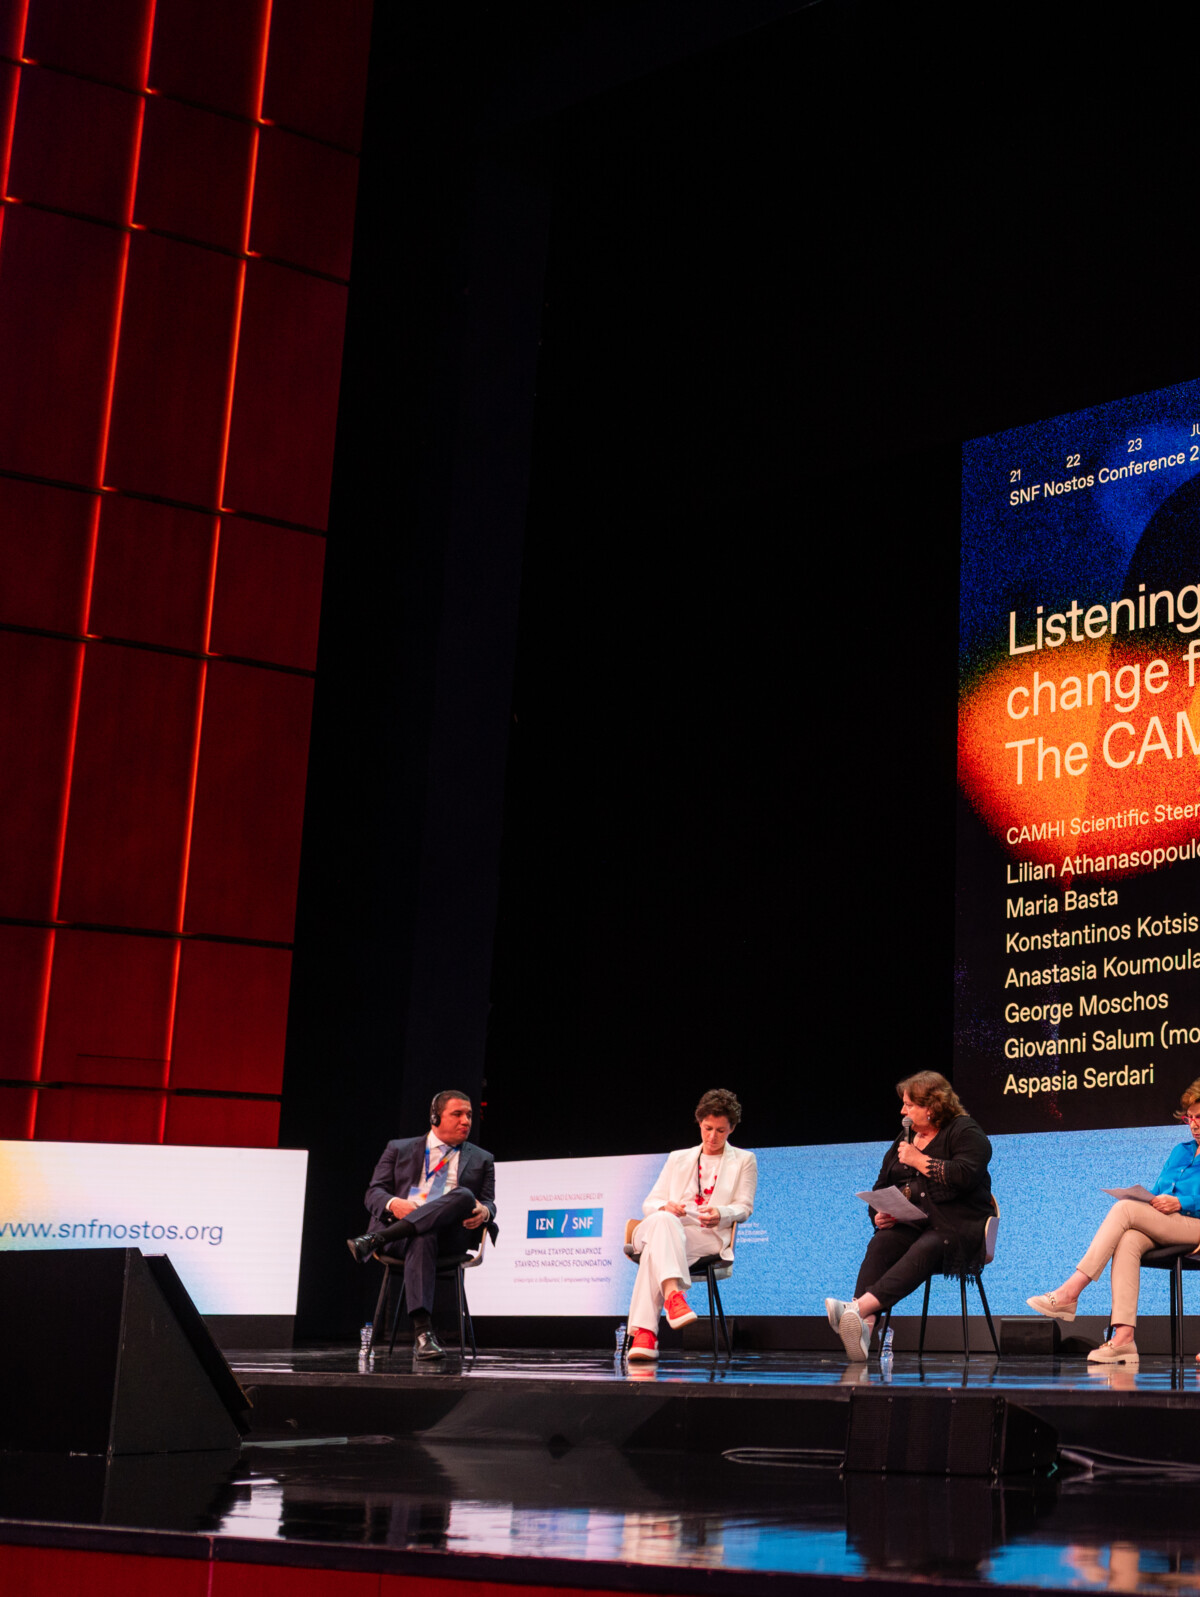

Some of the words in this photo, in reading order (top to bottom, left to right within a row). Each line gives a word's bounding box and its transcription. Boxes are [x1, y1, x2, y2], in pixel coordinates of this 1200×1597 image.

[1010, 469, 1021, 483] 21
[1066, 453, 1081, 468] 22
[1127, 437, 1143, 453] 23
[1009, 484, 1041, 506] SNF
[1044, 475, 1095, 498] Nostos
[1098, 452, 1186, 484] Conference
[1006, 659, 1170, 720] change
[1004, 730, 1089, 785] The
[1006, 819, 1065, 845] CAMHI
[1070, 808, 1150, 835] Scientific
[1007, 861, 1055, 884] Lilian
[1006, 894, 1058, 919] Maria
[1064, 887, 1118, 912] Basta
[1006, 923, 1131, 954] Konstantinos
[1137, 912, 1199, 938] Kotsis
[1004, 960, 1097, 989] Anastasia
[1005, 1002, 1073, 1025] George
[1079, 990, 1169, 1017] Moschos
[1004, 1032, 1087, 1059] Giovanni
[1092, 1028, 1154, 1052] Salum
[1003, 1070, 1078, 1098] Aspasia
[1083, 1063, 1154, 1089] Serdari
[572, 1217, 593, 1229] SNF
